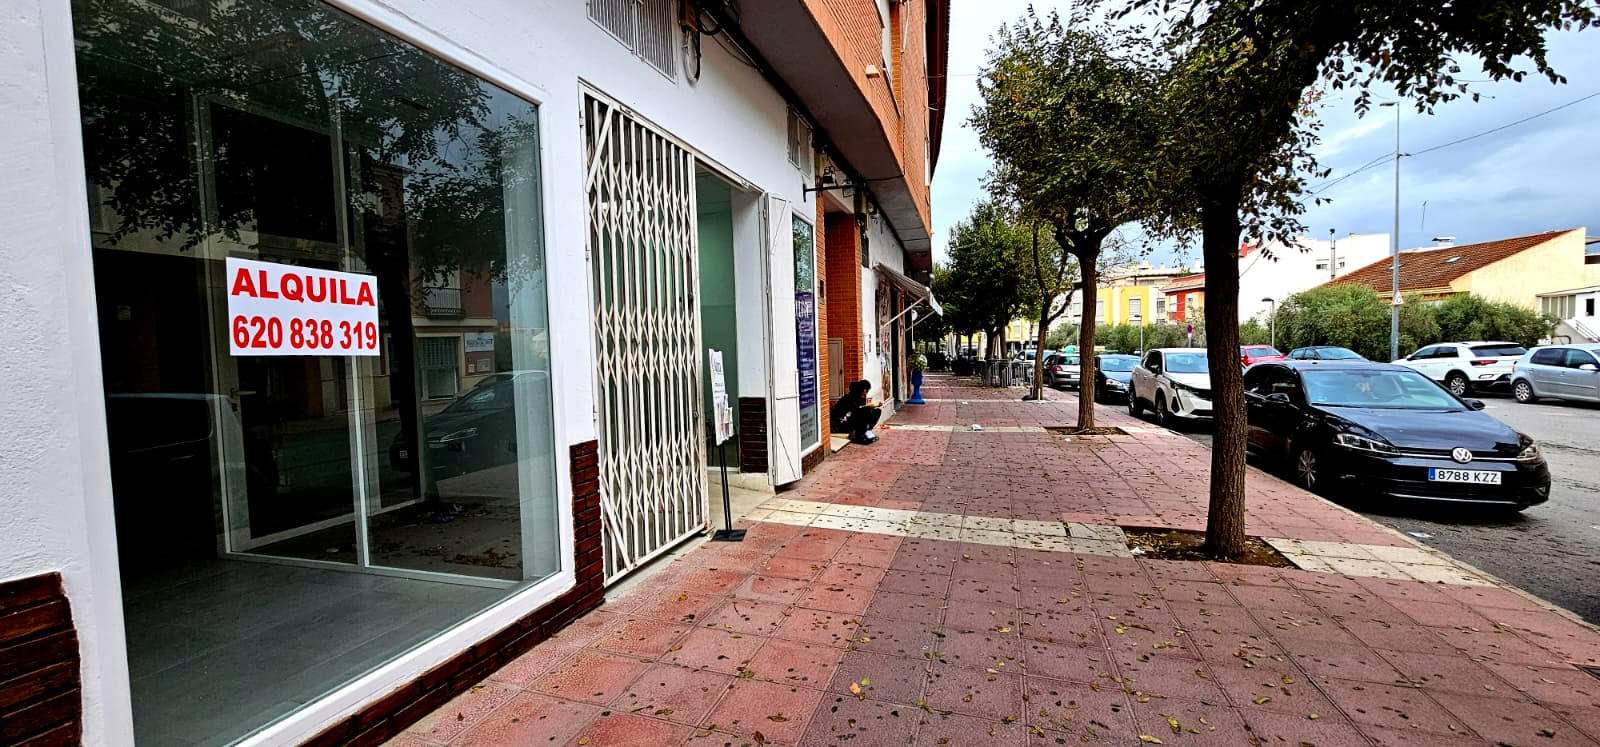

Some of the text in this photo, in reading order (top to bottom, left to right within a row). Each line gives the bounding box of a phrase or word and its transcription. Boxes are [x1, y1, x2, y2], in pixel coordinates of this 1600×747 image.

[231, 267, 375, 307] ALQUILA
[233, 315, 377, 350] 620 838 319
[1438, 470, 1498, 483] 8788 KZZ
